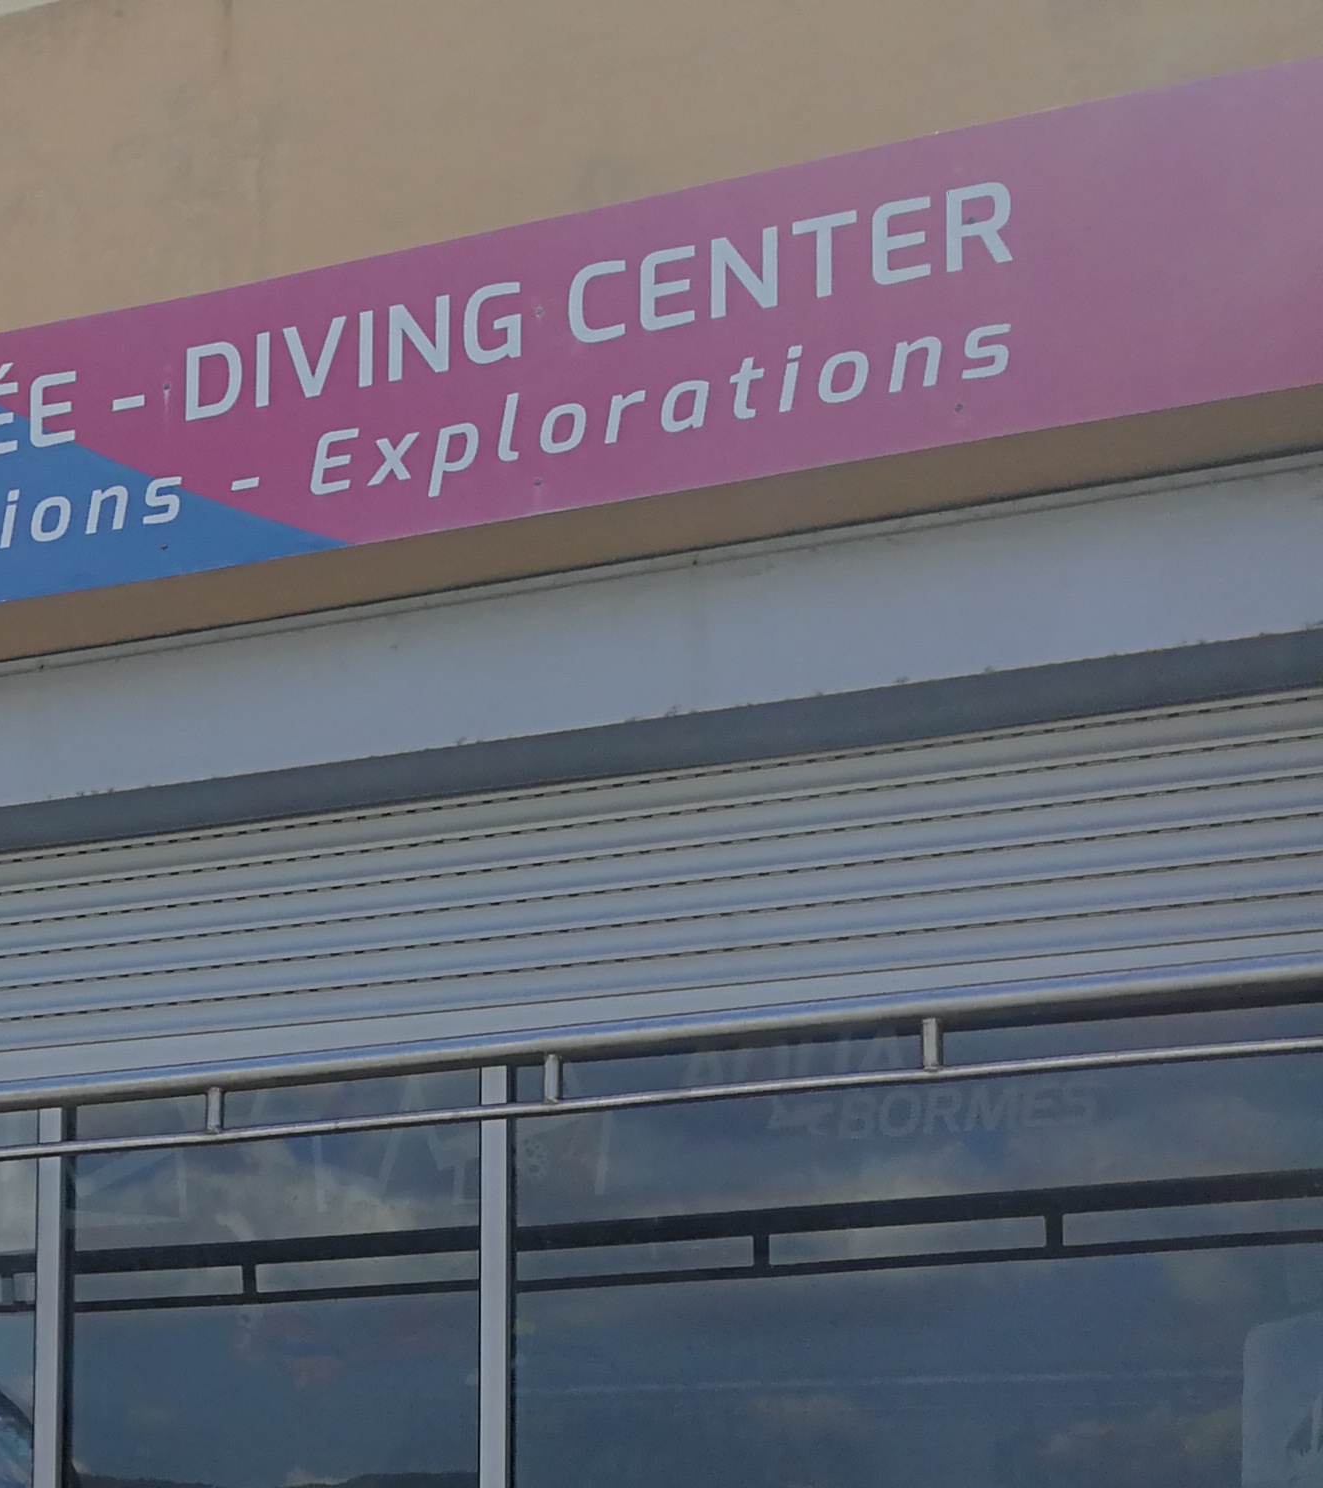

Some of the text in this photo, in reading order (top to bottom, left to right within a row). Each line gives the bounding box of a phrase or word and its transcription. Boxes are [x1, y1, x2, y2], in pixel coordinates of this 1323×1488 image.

[185, 281, 522, 422] DIVING
[567, 181, 1014, 345] CENTER
[310, 323, 1012, 498] Explorations
